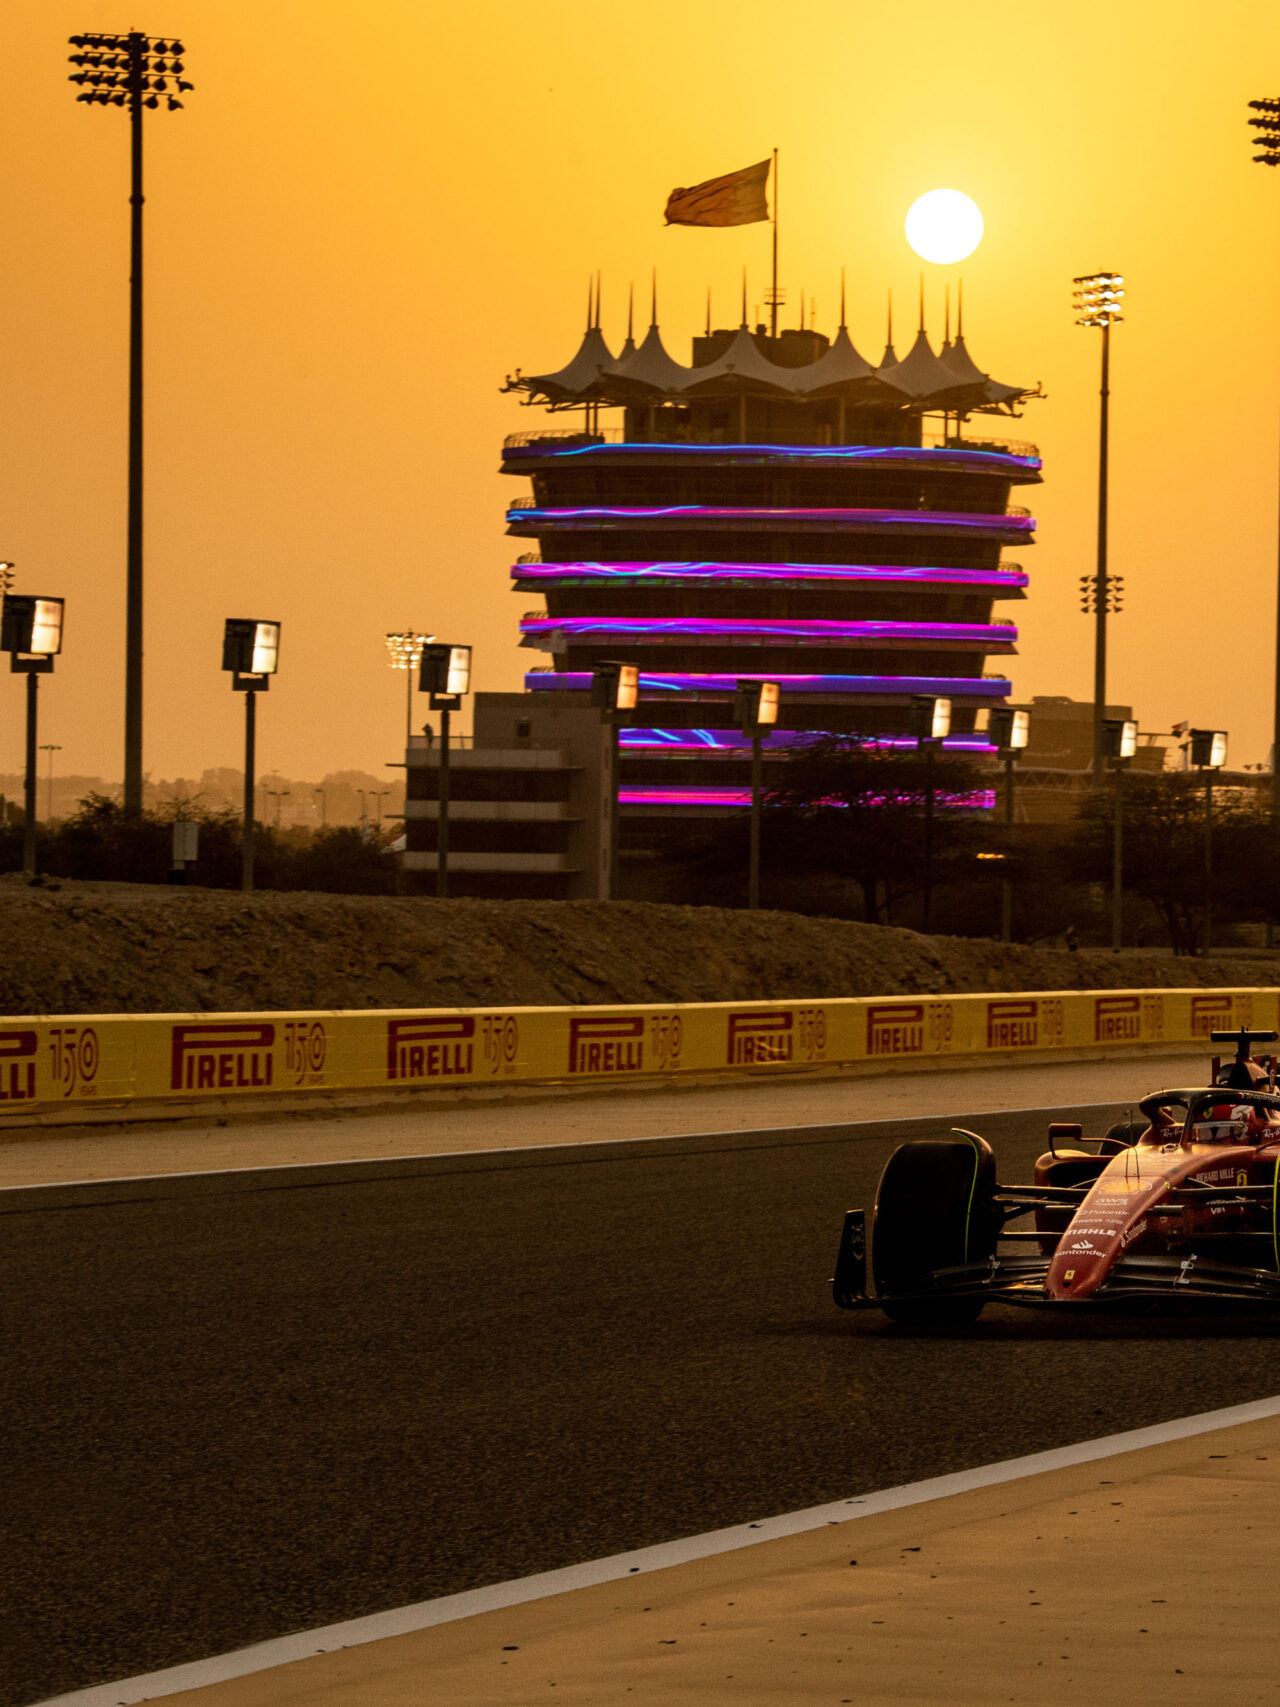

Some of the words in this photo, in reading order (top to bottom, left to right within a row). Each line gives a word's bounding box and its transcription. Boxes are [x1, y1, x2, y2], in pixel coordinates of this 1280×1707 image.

[568, 1016, 645, 1073] PIRELLI
[727, 1011, 793, 1064] PIRELLI
[866, 1004, 924, 1055] PIRELLI
[987, 1001, 1038, 1048] PIRELLI
[1094, 997, 1141, 1041] PIRELLI
[171, 1024, 276, 1090] PIRELLI
[387, 1017, 475, 1079] PIRELLI
[1219, 1167, 1235, 1180] MILLE
[1067, 1228, 1117, 1237] MAHLE
